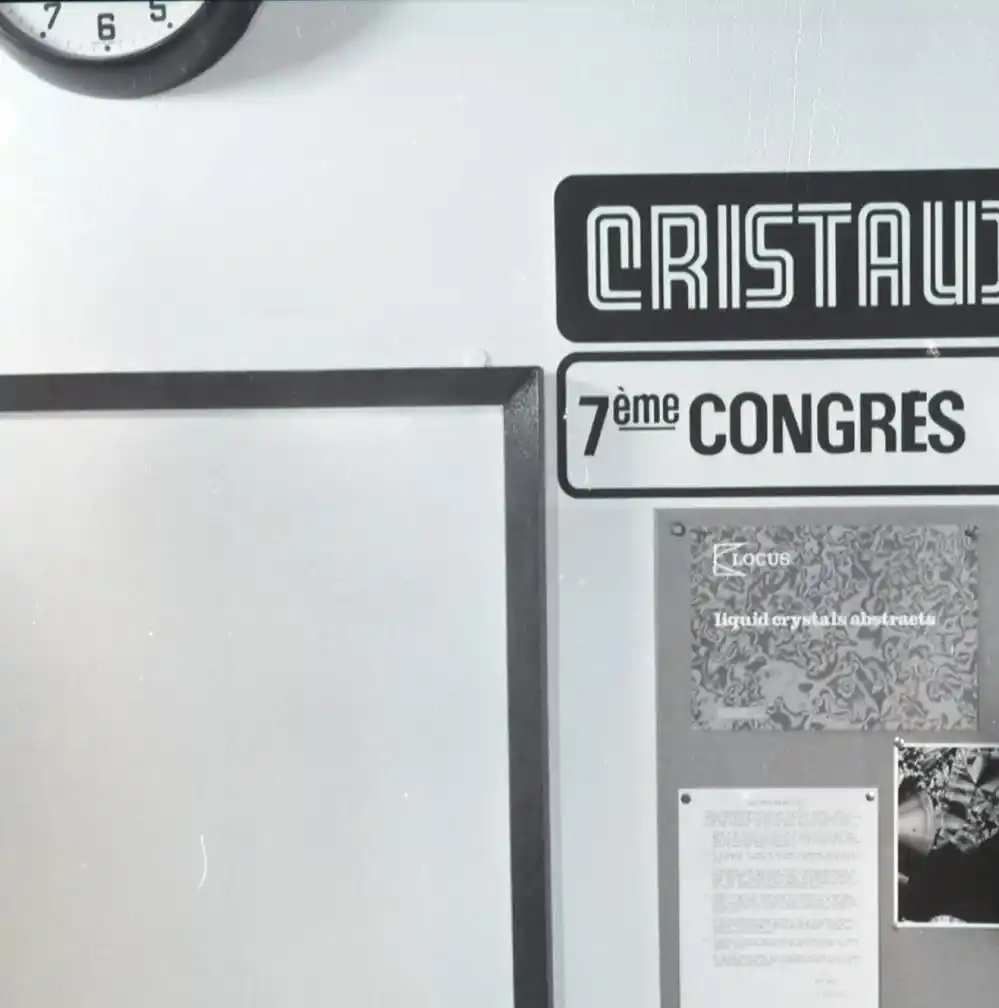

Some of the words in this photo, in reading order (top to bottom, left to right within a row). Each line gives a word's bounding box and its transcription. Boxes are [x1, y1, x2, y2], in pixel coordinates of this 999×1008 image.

[43, 2, 62, 30] 7
[148, 2, 167, 22] 5
[97, 13, 116, 41] 6
[731, 552, 792, 567] LOCUS
[714, 611, 768, 632] liquid
[772, 611, 847, 632] crystals
[850, 611, 936, 627] abstracts
